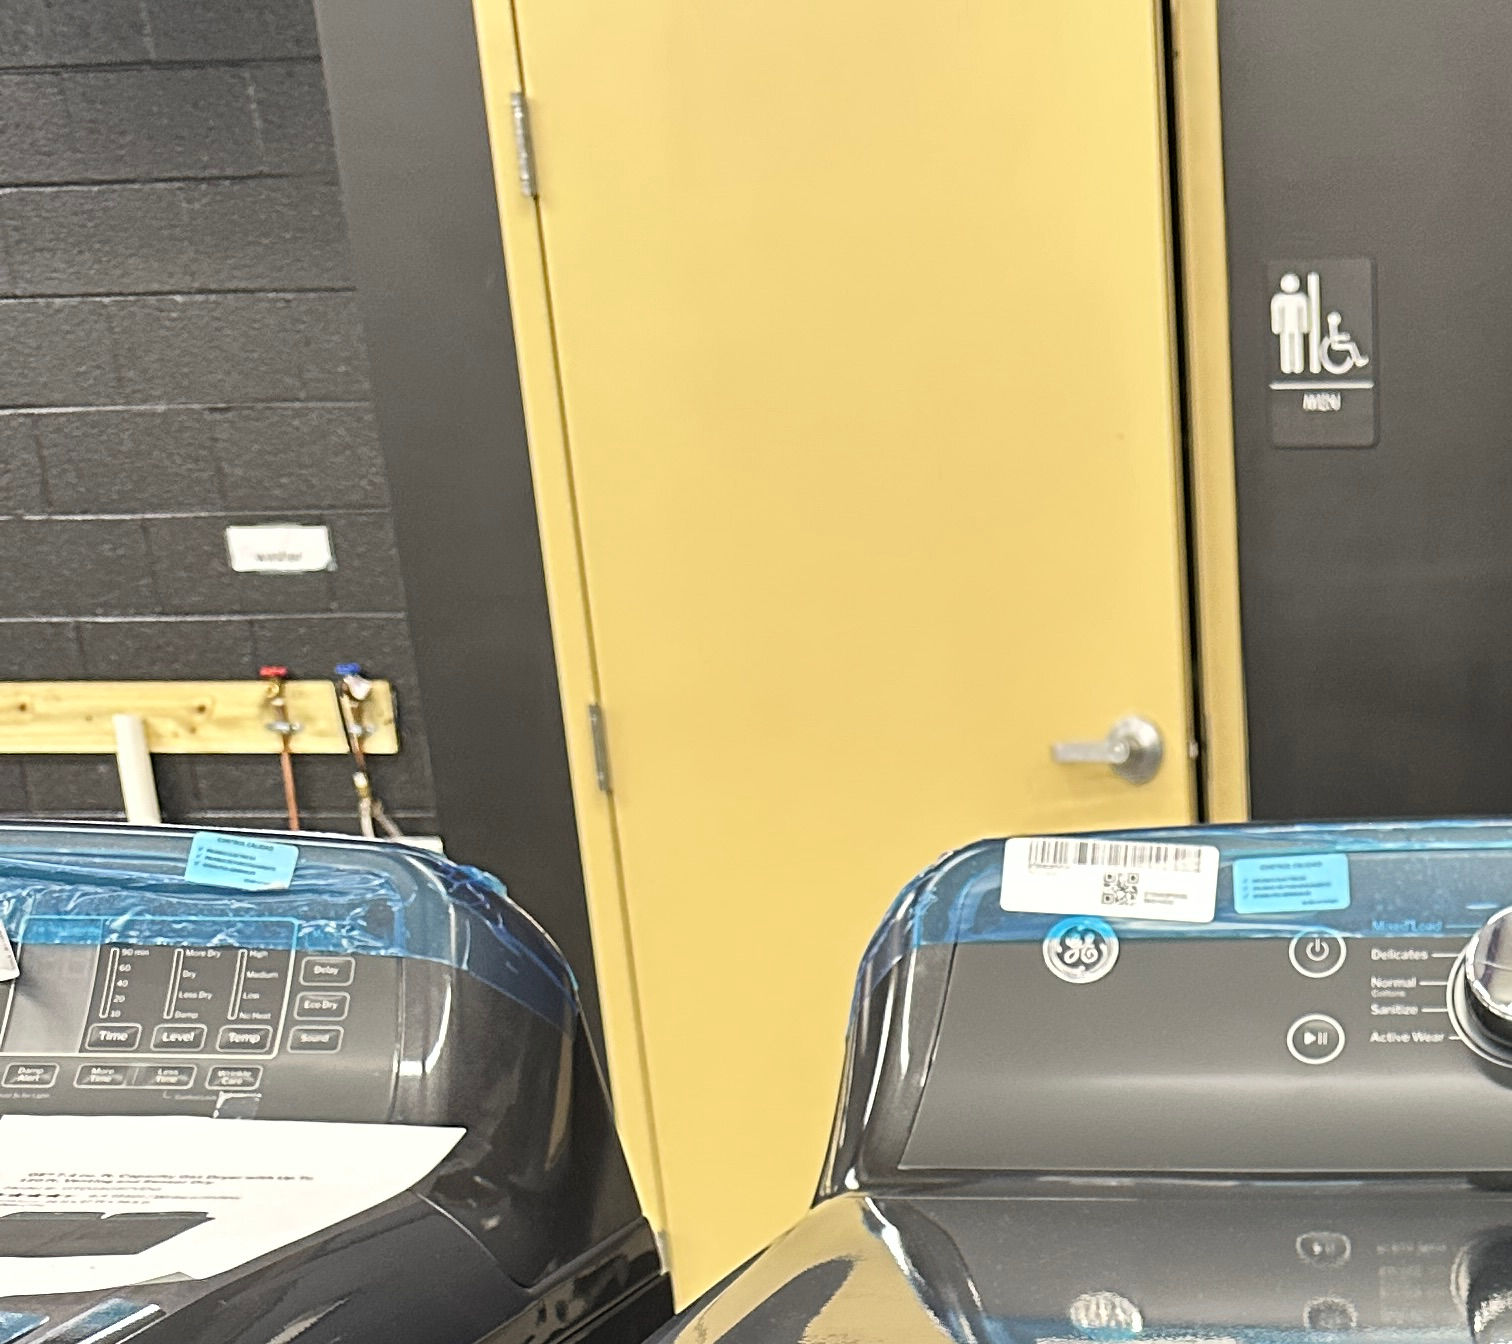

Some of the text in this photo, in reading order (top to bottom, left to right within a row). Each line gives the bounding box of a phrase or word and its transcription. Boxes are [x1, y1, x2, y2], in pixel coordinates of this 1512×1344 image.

[1302, 392, 1342, 412] MEN
[121, 949, 134, 957] 90
[185, 949, 221, 958] More Dry
[249, 950, 268, 959] High
[1371, 949, 1429, 961] Delicates
[119, 964, 132, 972] 60
[313, 965, 339, 975] Delay
[182, 970, 197, 979] Dry
[246, 970, 279, 979] Medium
[116, 979, 129, 987] 40
[1370, 976, 1417, 989] Normal
[113, 994, 126, 1003] 20
[179, 991, 213, 1000] Less Dry
[303, 1000, 338, 1011] Eco Dry
[1370, 1004, 1419, 1015] Sanitize
[110, 1010, 121, 1018] 10
[174, 1011, 199, 1019] Damp
[99, 1030, 128, 1041] Time
[161, 1031, 195, 1042] Level
[228, 1032, 261, 1043] Temp
[1370, 1032, 1445, 1043] Active Wear
[91, 1067, 115, 1076] More
[157, 1068, 179, 1076] Less
[90, 1075, 112, 1083] Time
[221, 1077, 243, 1085] Care
